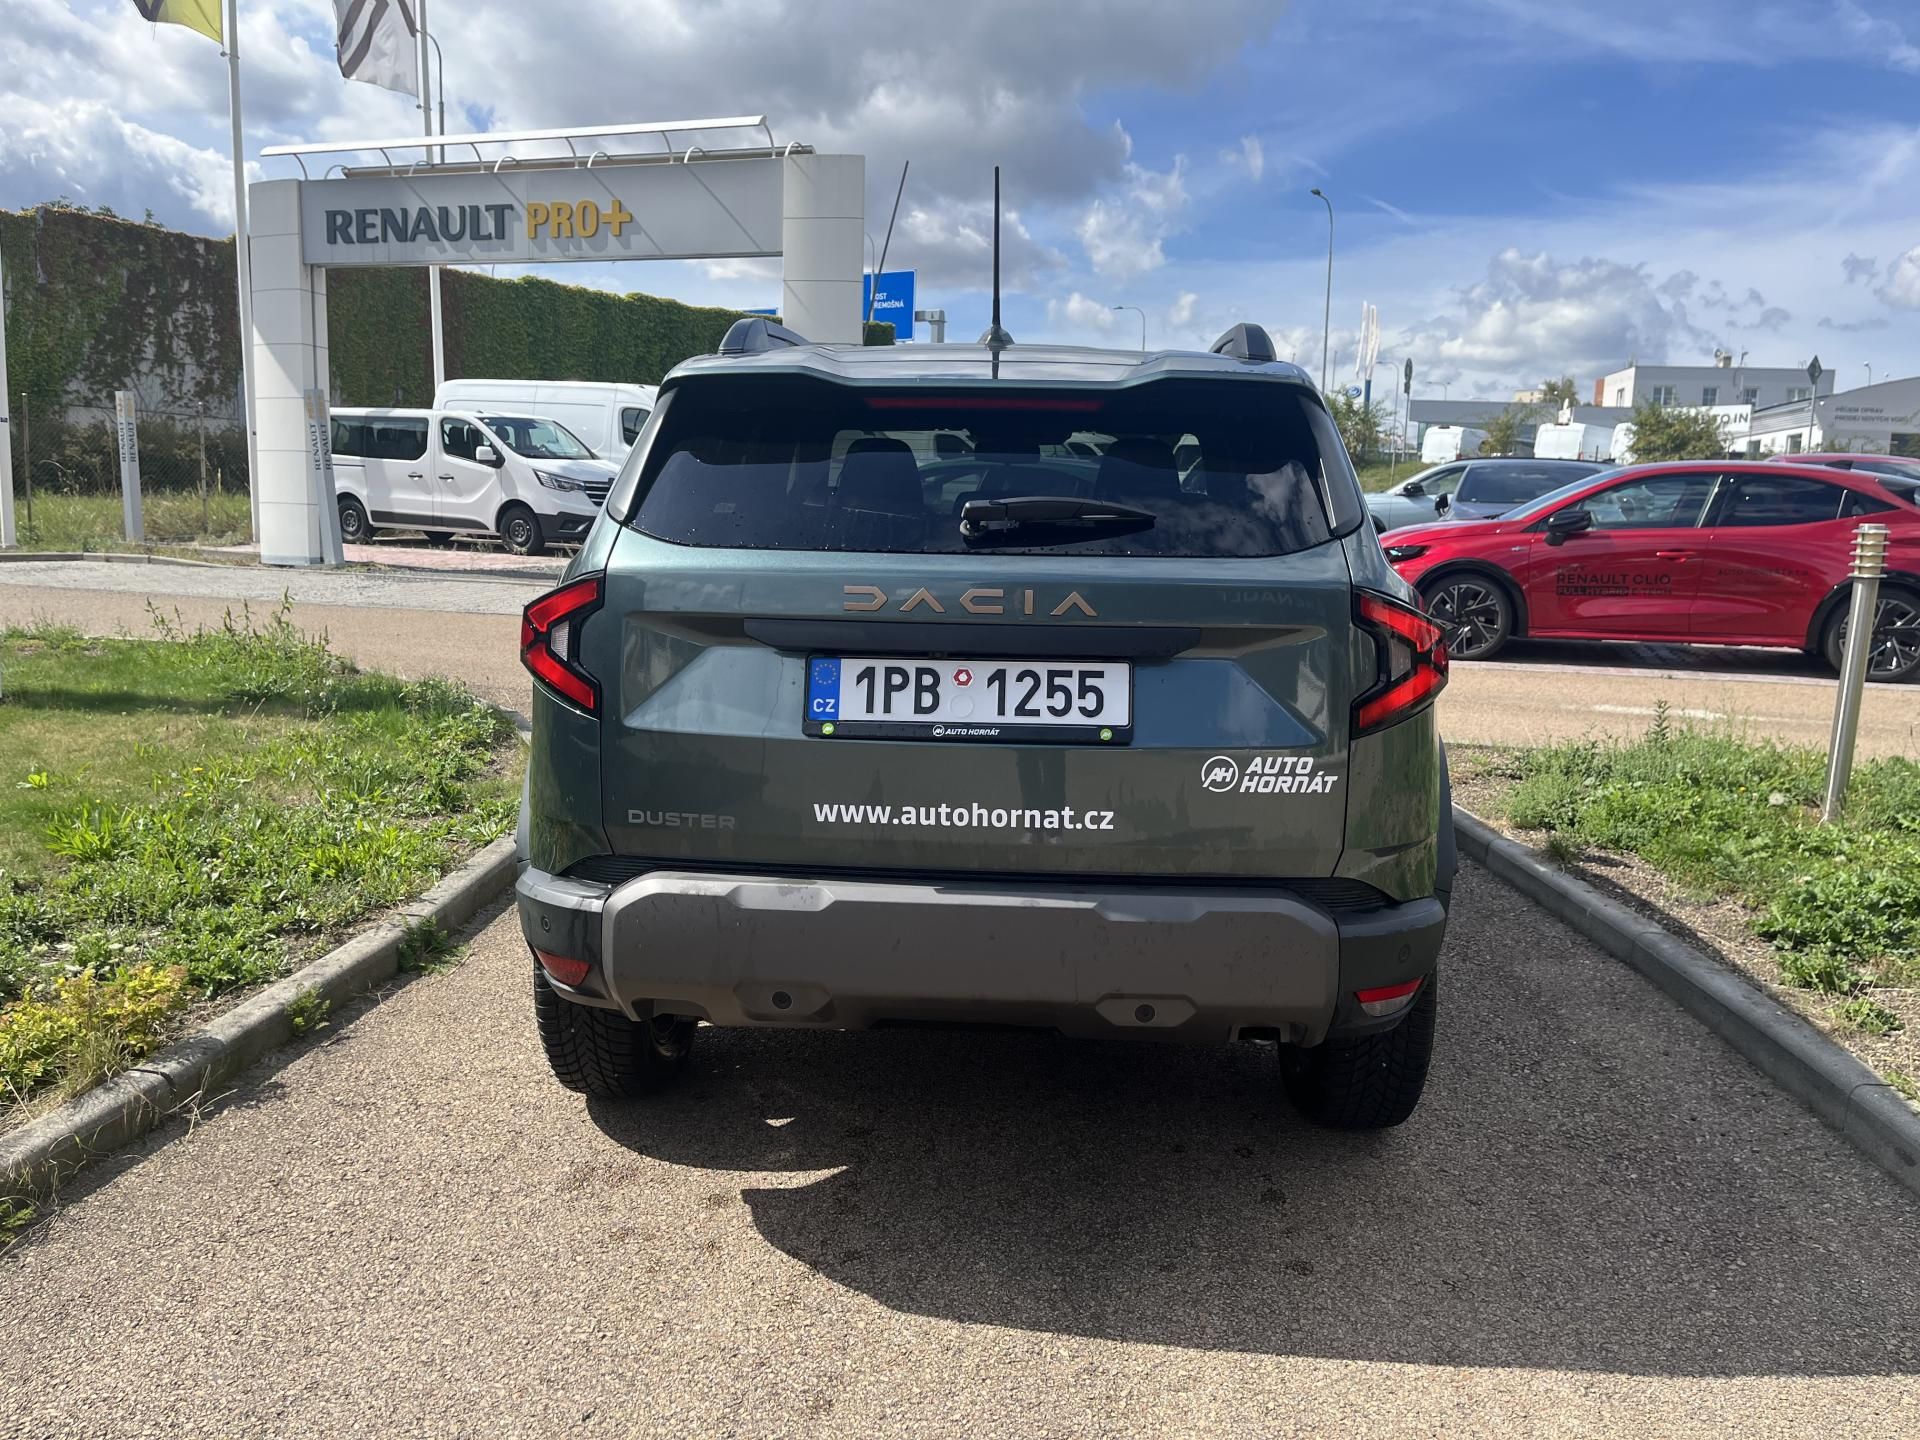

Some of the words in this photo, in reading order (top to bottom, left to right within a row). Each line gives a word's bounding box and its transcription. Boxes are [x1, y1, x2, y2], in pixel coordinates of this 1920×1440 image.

[325, 203, 514, 245] RENAULT
[527, 199, 633, 239] PRO+
[119, 421, 127, 463] RENAULT
[127, 421, 136, 463] RENAULT
[309, 424, 322, 471] RENAULT
[320, 424, 332, 471] RENAULT
[1556, 573, 1629, 585] RENAULT
[1632, 573, 1671, 585] CLIO
[843, 585, 1098, 618] DACIA
[813, 698, 836, 713] CZ
[856, 666, 941, 715] 1PB
[987, 668, 1105, 718] 1255
[1245, 756, 1314, 774] AUTO
[1239, 771, 1338, 793] HORNÁT
[628, 809, 736, 830] DUSTER
[813, 802, 1115, 830] www.autohornat.cz
